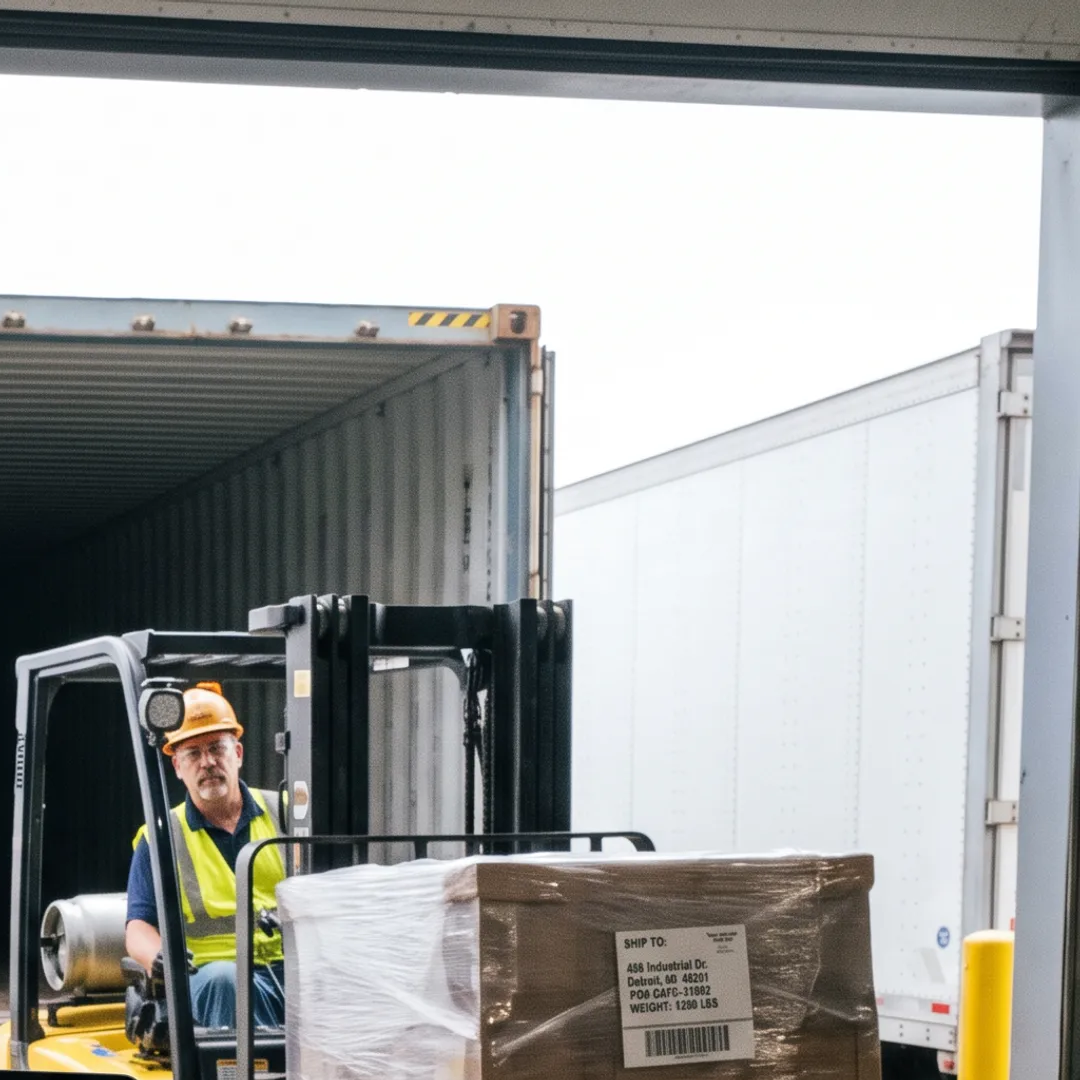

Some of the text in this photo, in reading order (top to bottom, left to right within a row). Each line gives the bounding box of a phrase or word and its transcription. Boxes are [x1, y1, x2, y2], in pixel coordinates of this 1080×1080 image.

[624, 936, 667, 949] SHIP TO:
[647, 959, 692, 972] Industrial
[694, 958, 708, 970] Dr.
[628, 975, 663, 988] Detroit,
[630, 1002, 672, 1014] WEIGHT:
